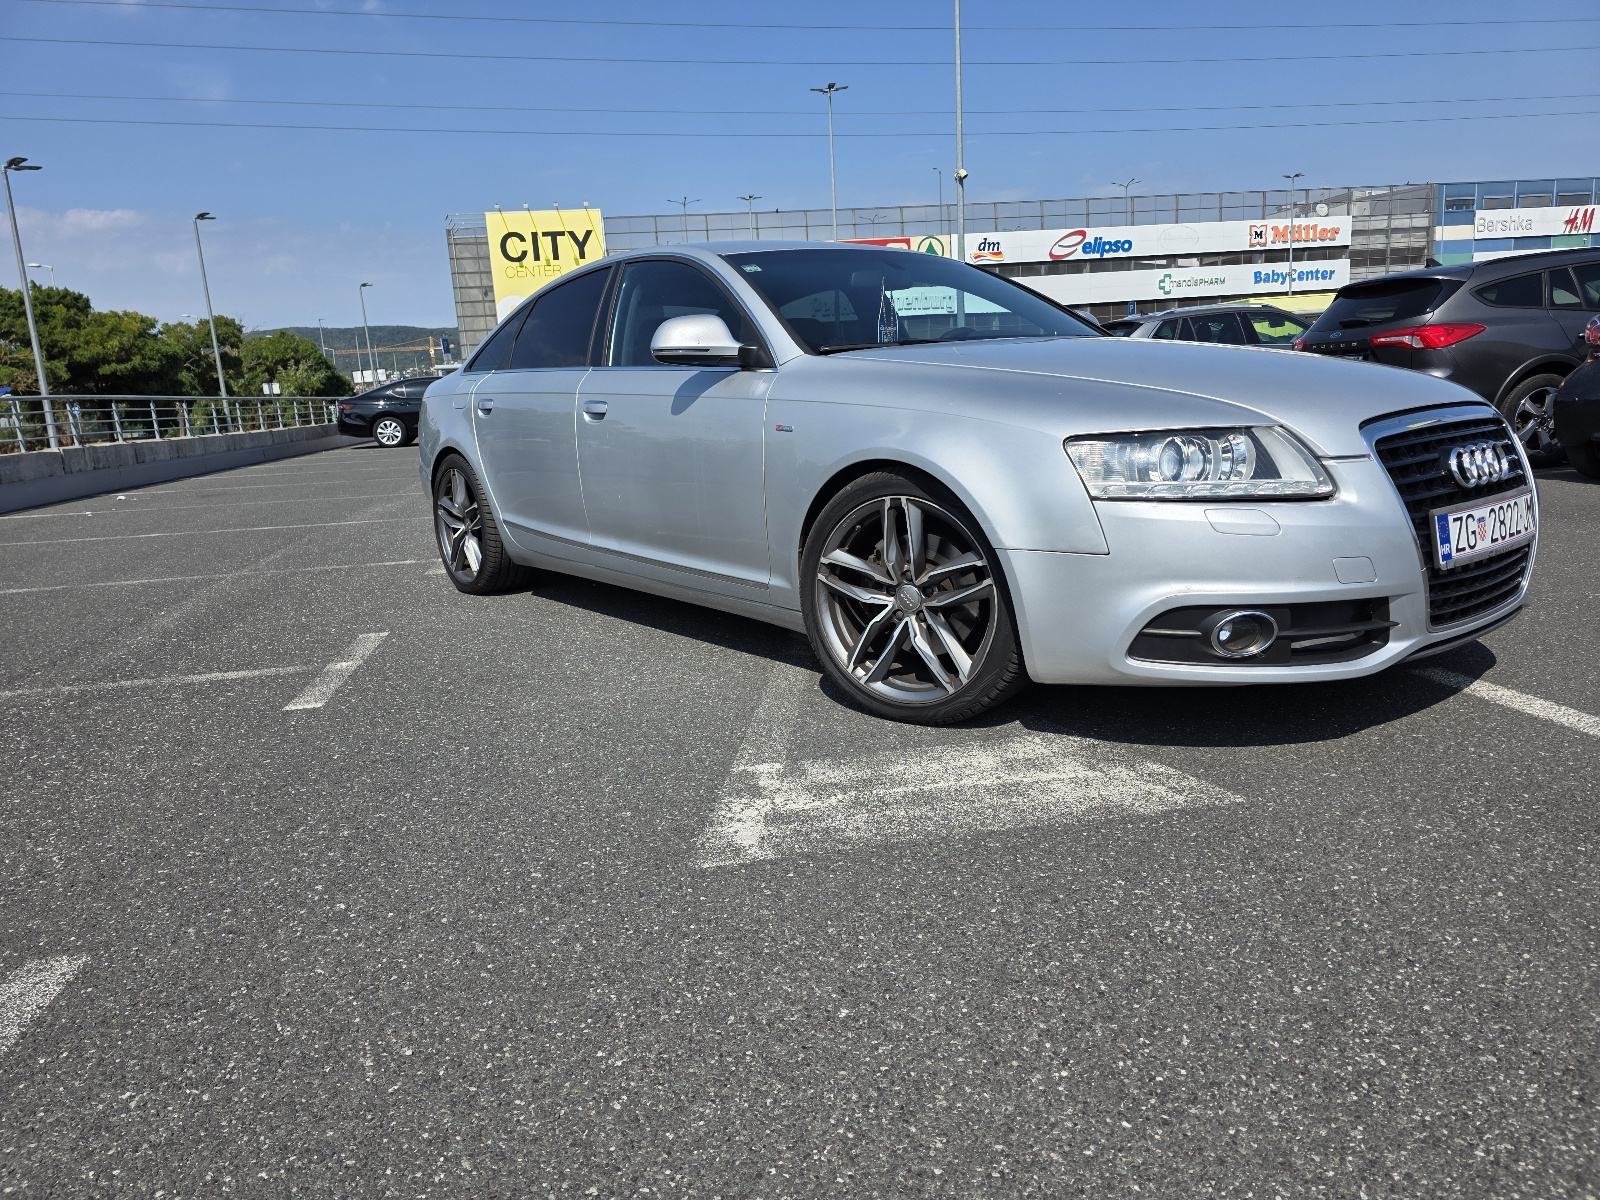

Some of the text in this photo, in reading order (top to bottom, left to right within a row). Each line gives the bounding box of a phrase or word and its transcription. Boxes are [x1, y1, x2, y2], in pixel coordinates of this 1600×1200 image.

[1477, 216, 1533, 232] Bershka
[1563, 208, 1595, 233] H&M
[500, 230, 592, 262] CITY
[978, 237, 1001, 252] dm
[1082, 237, 1132, 257] elipso
[505, 264, 562, 279] CENTER
[1452, 514, 1477, 553] ZG
[1440, 544, 1451, 555] HR
